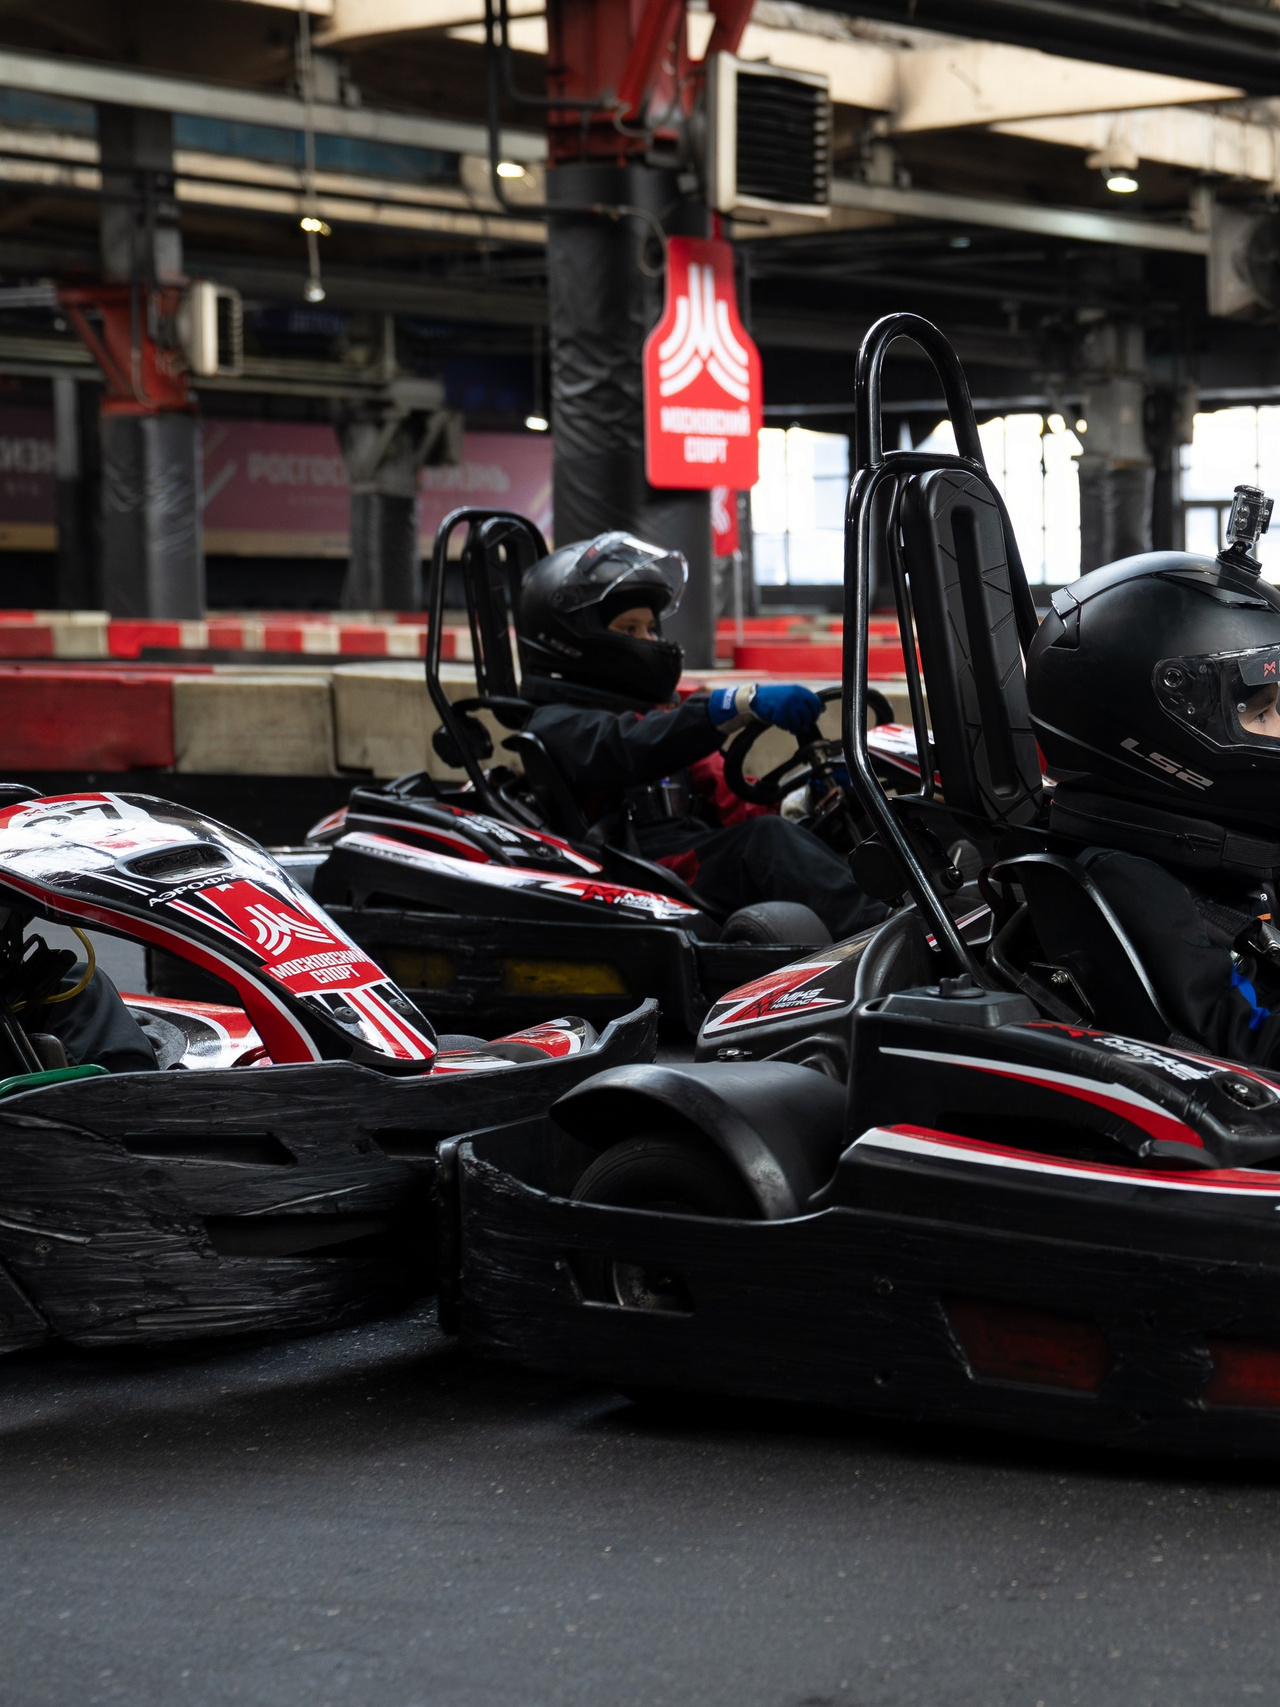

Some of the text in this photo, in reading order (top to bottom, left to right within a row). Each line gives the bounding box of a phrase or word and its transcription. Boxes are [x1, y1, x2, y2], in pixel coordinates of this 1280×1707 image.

[1120, 737, 1214, 791] LS2
[268, 947, 374, 980] МОСКОВСКИЙ
[309, 964, 361, 985] СПОРТ
[776, 987, 825, 1003] MIKS
